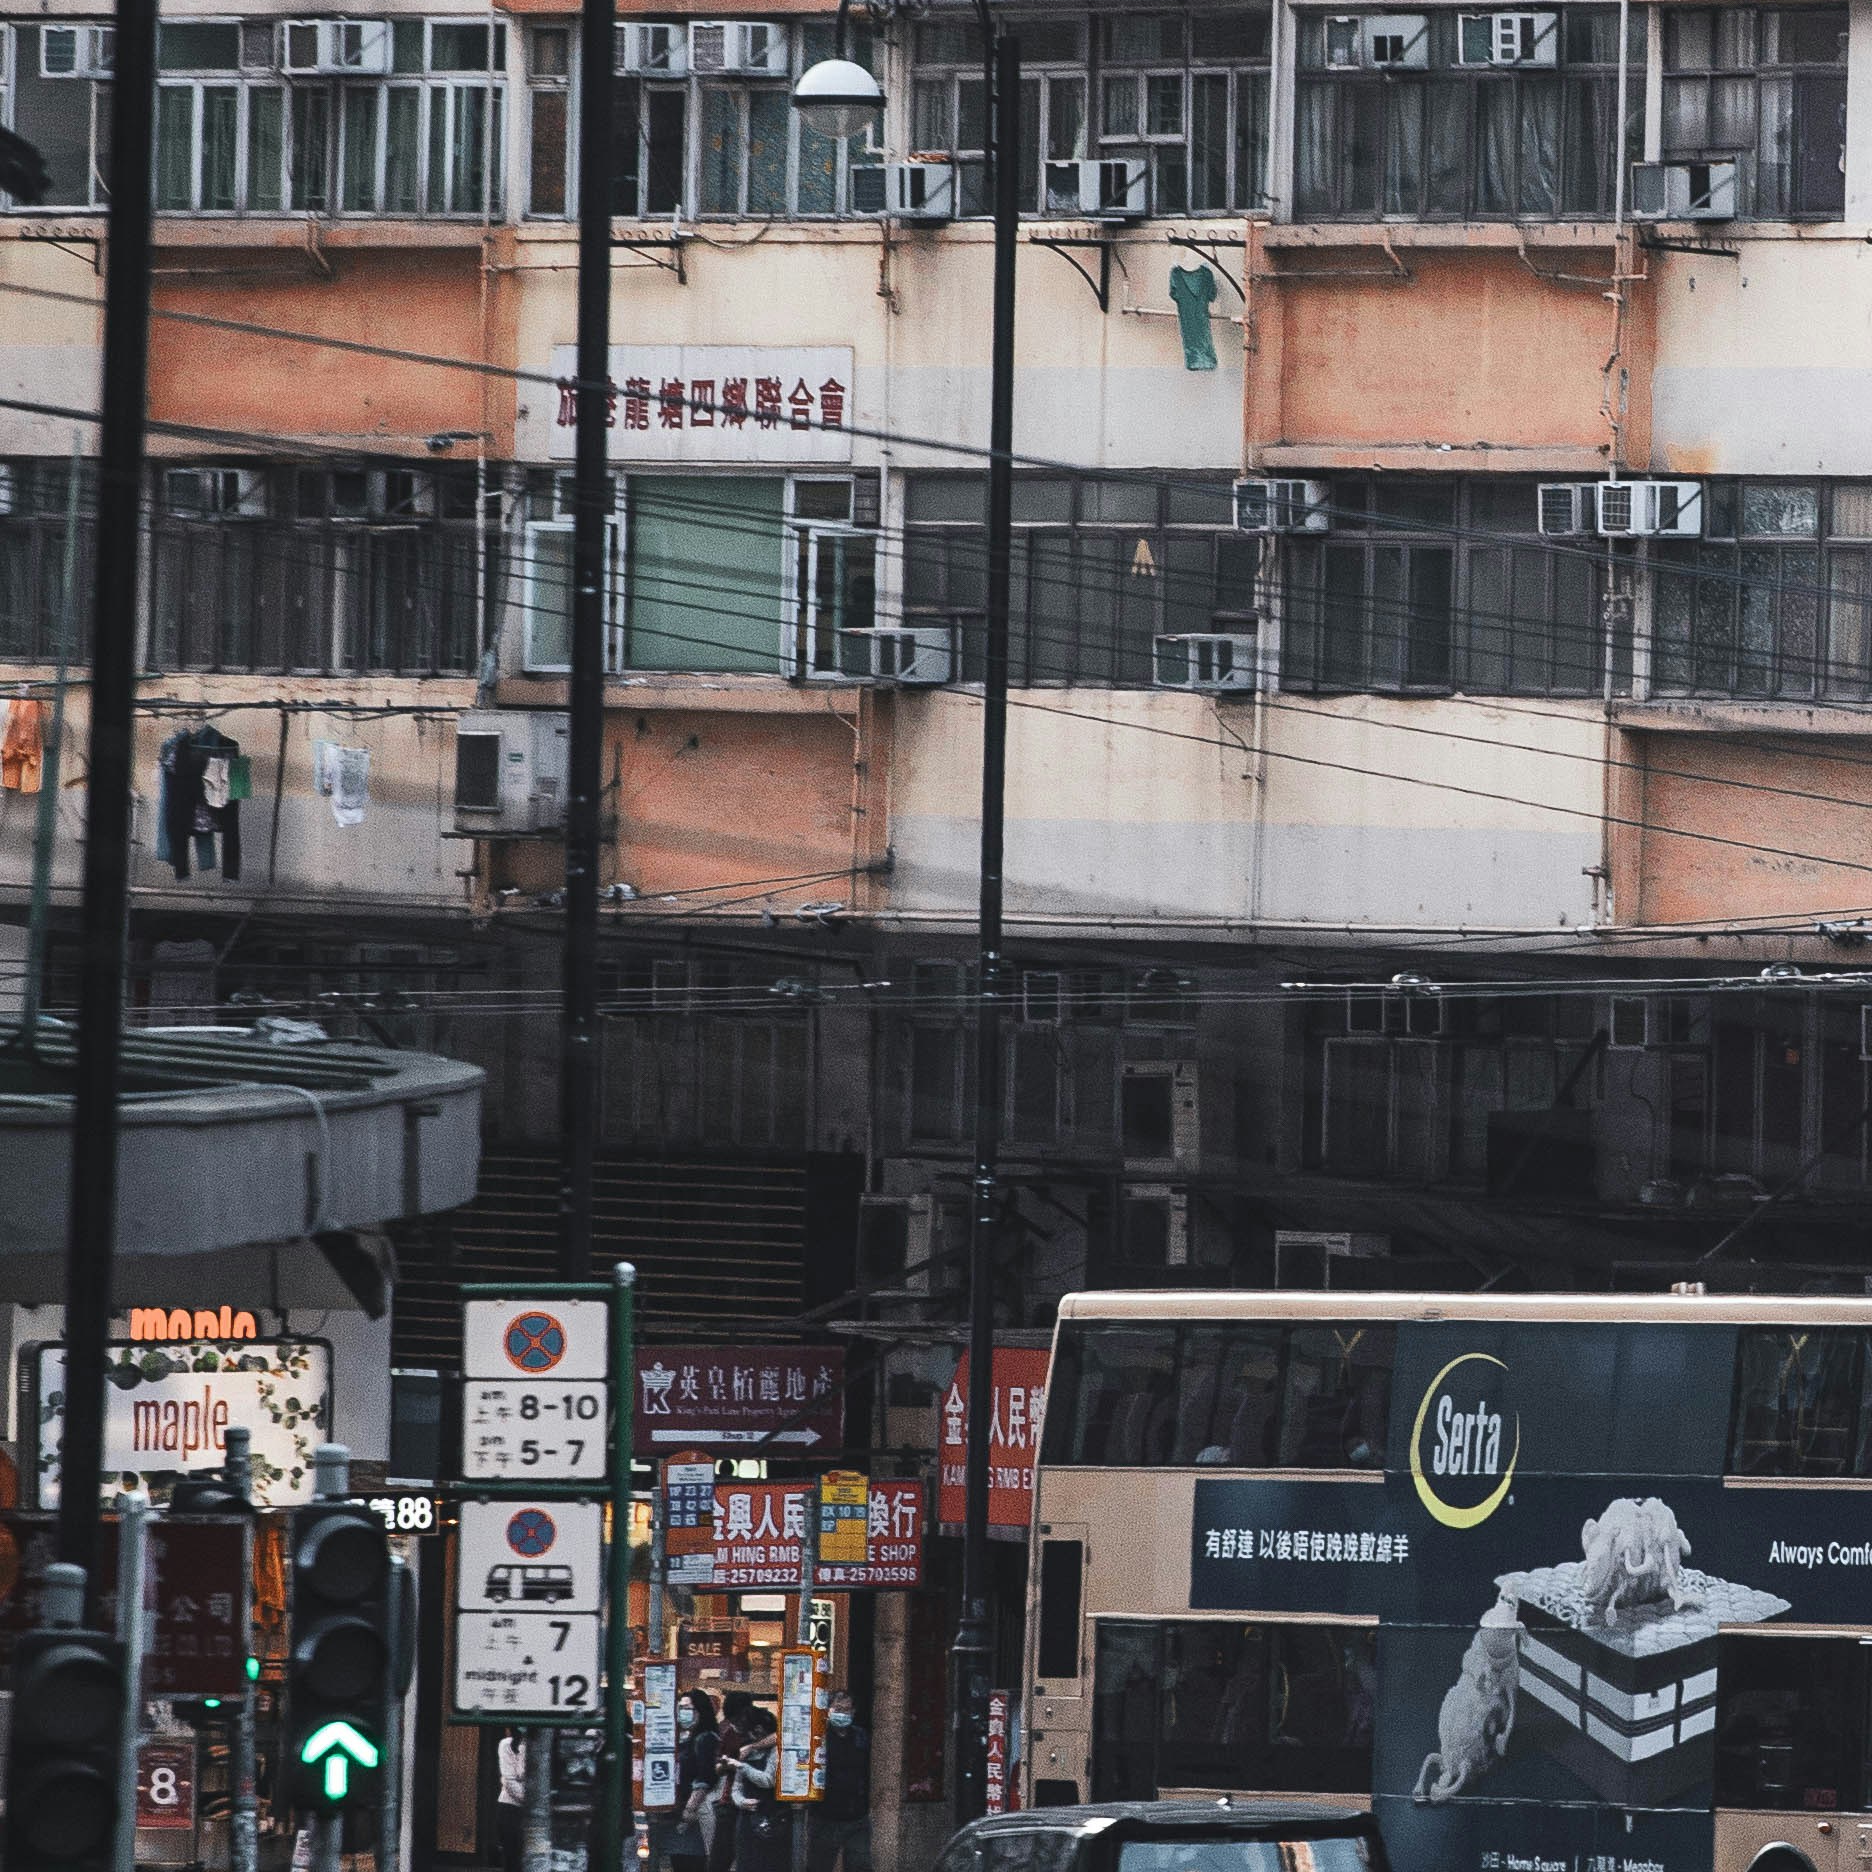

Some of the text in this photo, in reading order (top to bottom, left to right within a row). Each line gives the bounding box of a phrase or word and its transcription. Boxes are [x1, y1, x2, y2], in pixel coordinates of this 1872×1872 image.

[133, 1384, 229, 1462] maple
[519, 1393, 599, 1421] 8-10
[1432, 1393, 1503, 1478] Serta
[880, 1544, 917, 1563] SHOP
[1204, 1527, 1254, 1560] 有舒達
[1768, 1540, 1823, 1569] Always
[547, 1620, 571, 1653] 7
[687, 1642, 722, 1657] SALE
[547, 1674, 590, 1707] 12
